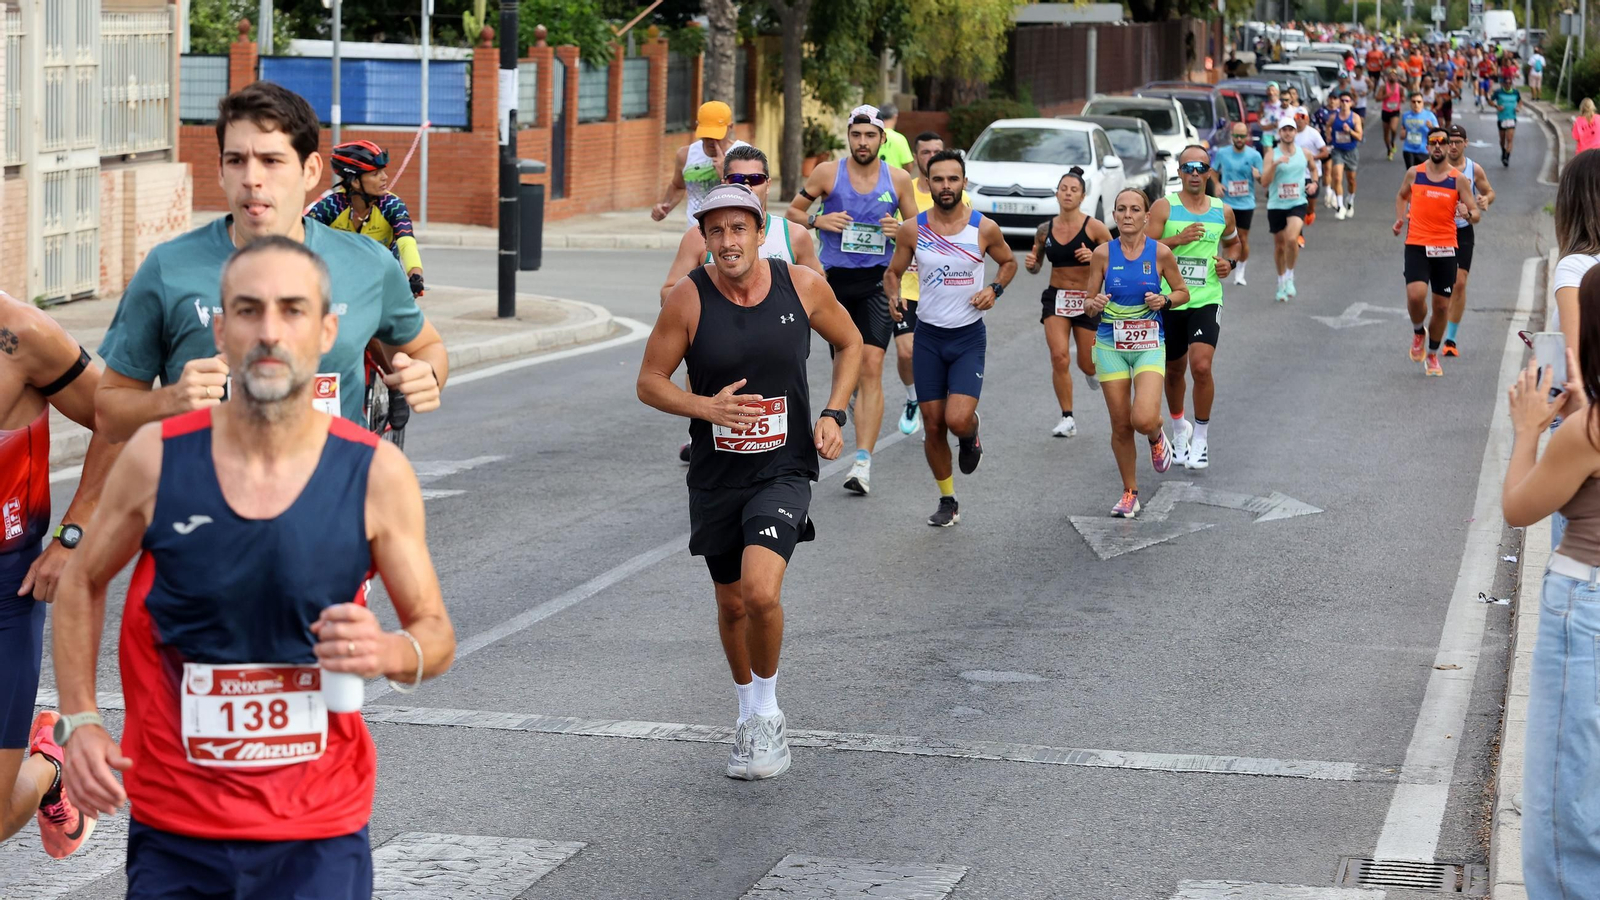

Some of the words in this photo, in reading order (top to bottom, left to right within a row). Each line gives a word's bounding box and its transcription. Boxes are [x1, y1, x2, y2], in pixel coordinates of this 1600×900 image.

[710, 194, 744, 202] SALOMON
[856, 232, 872, 243] 42
[1180, 266, 1195, 276] 67
[1065, 299, 1083, 308] 239
[1125, 329, 1148, 341] 299
[220, 698, 289, 732] 138
